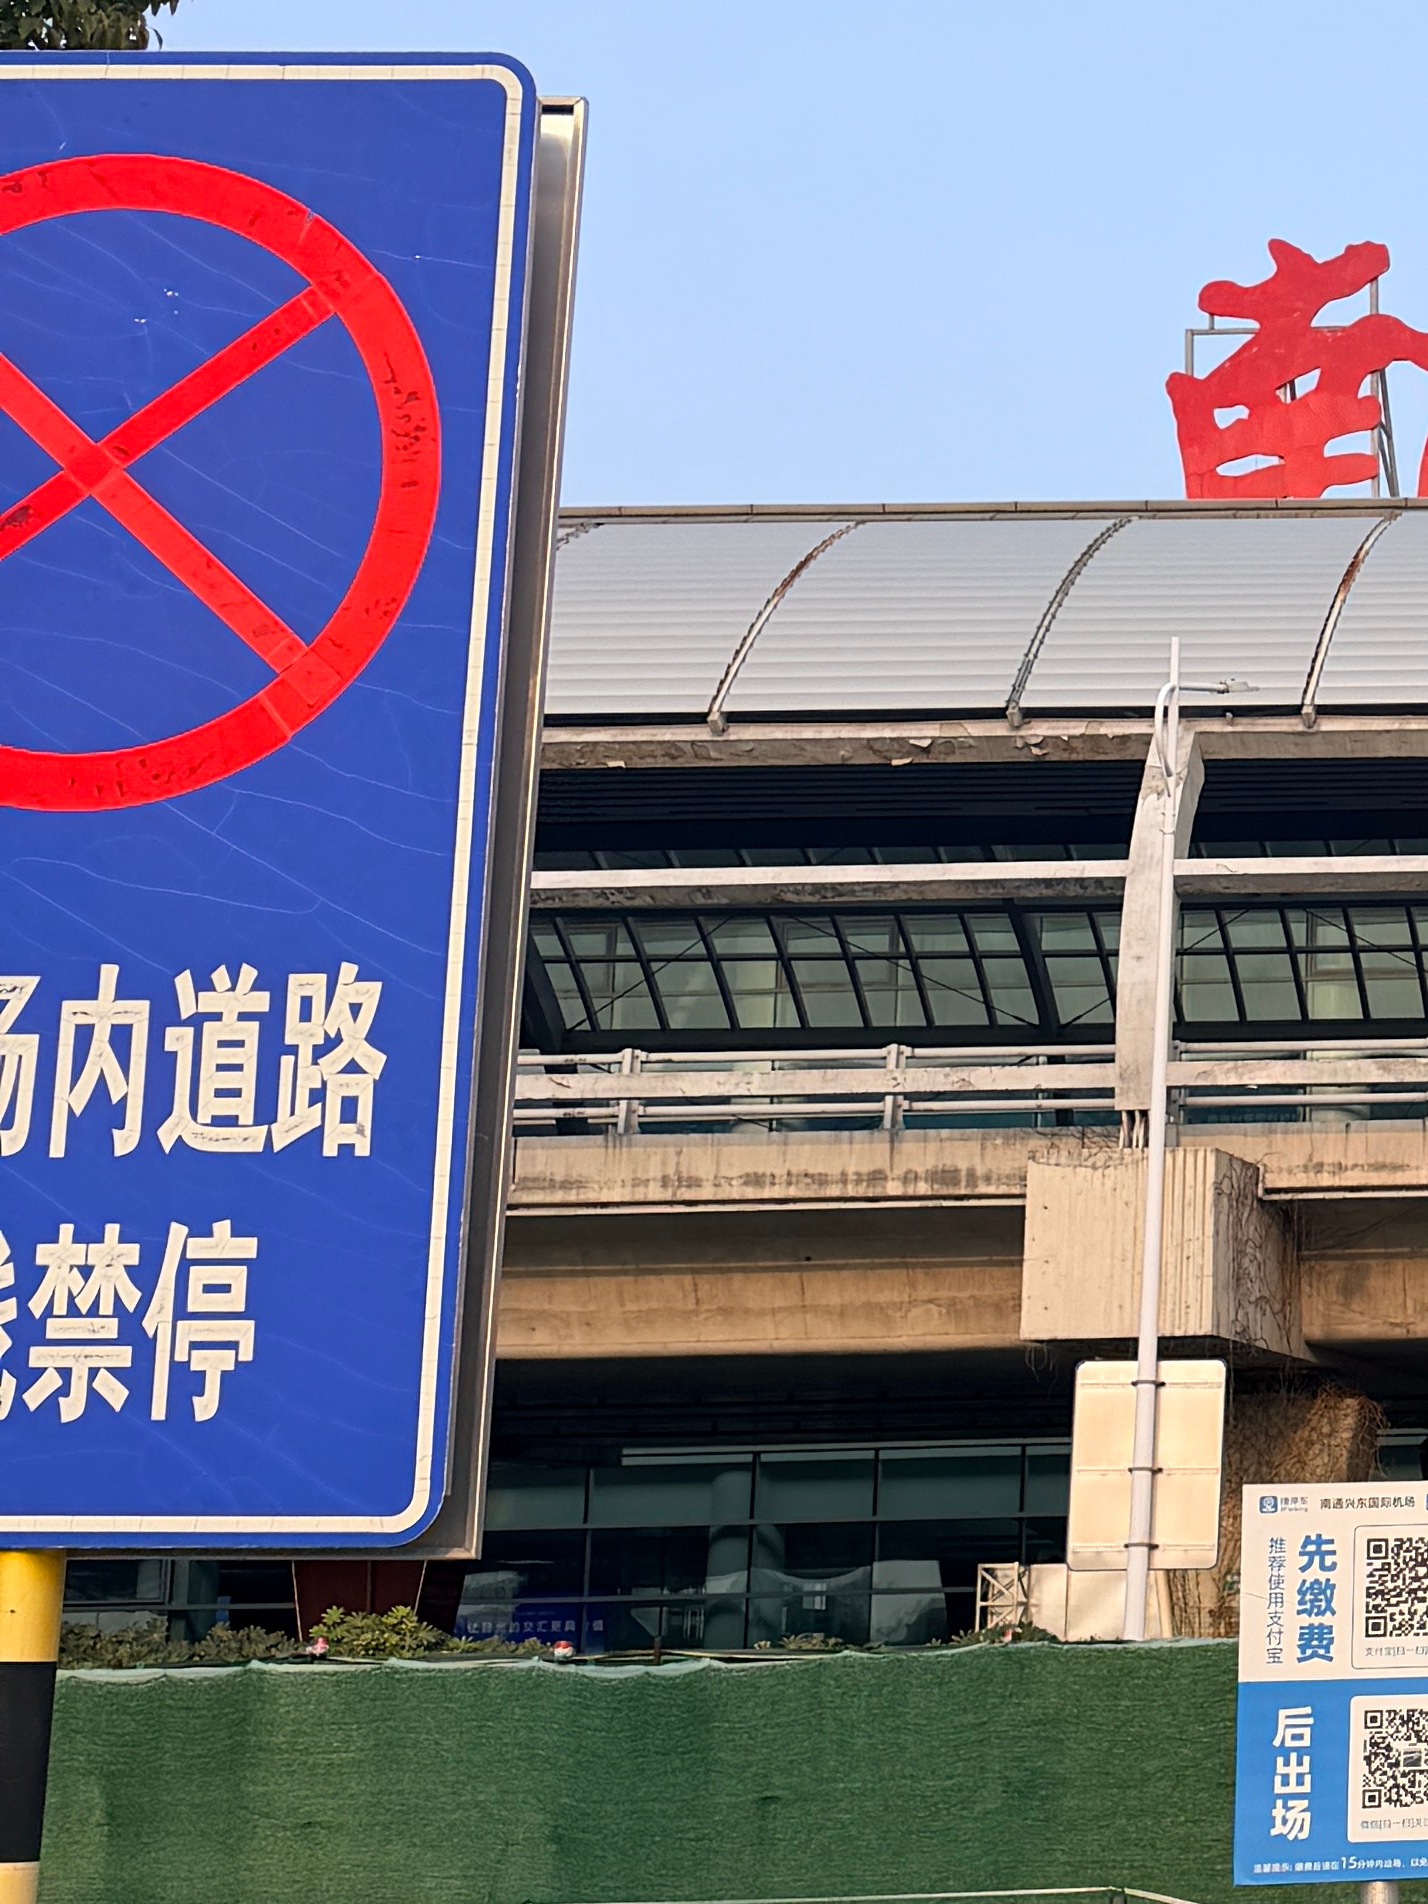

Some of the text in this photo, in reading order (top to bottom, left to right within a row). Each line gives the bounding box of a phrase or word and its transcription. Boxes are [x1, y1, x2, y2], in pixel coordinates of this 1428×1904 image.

[0, 1219, 258, 1423] 禁停
[1320, 1496, 1415, 1510] 南通兴东国际机场
[1266, 1537, 1286, 1664] 推荐使用支付宝
[1296, 1533, 1337, 1663] 先缴费
[1270, 1706, 1314, 1841] 后出场
